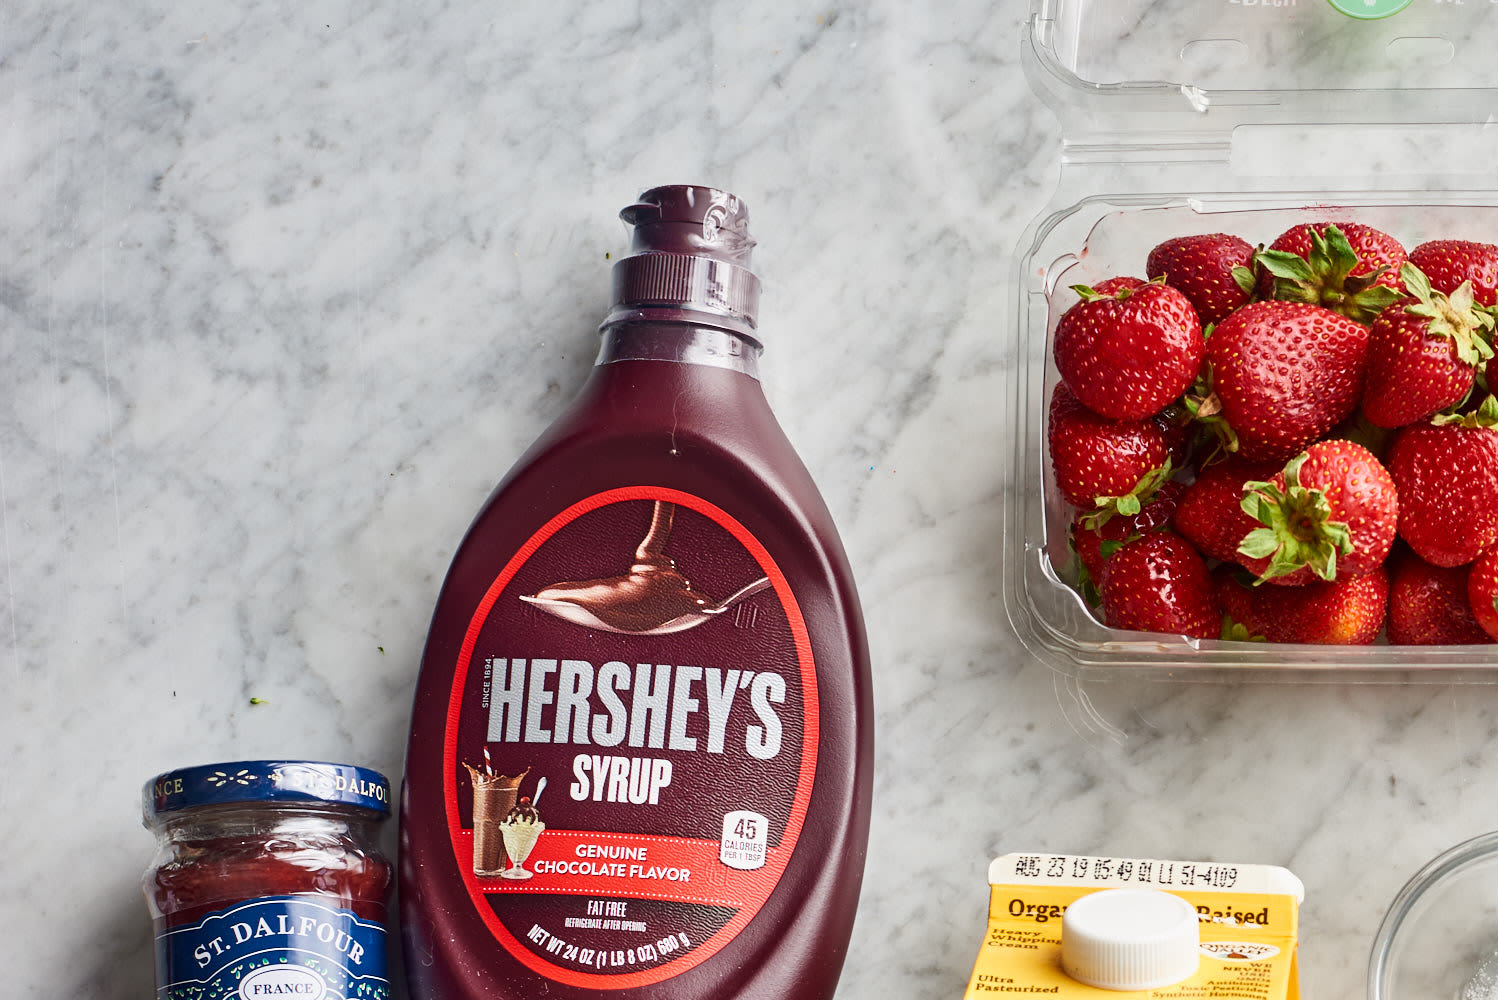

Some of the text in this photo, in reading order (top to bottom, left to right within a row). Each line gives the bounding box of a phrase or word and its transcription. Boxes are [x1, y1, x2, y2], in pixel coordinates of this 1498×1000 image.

[482, 681, 490, 708] SINCE
[487, 657, 787, 760] HERSHEY'S
[570, 754, 672, 805] SYRUP
[734, 818, 757, 840] 45
[575, 844, 647, 861] GENUINE
[724, 839, 763, 852] CALORIES
[534, 860, 691, 882] CHOCOLATE FLAVOR
[1046, 857, 1066, 878] 23
[1072, 857, 1088, 878] 19
[587, 900, 627, 918] FAT FREE
[564, 917, 647, 933] REFRIGERATE AFTER OPENING
[993, 928, 1042, 936] Heavy
[230, 915, 365, 965] DALFOUR
[988, 941, 1039, 949] Cream
[991, 935, 1062, 945] Whipping
[978, 975, 1014, 983] Ultra
[253, 983, 313, 995] FRANCE
[976, 983, 1059, 993] Pasteurized
